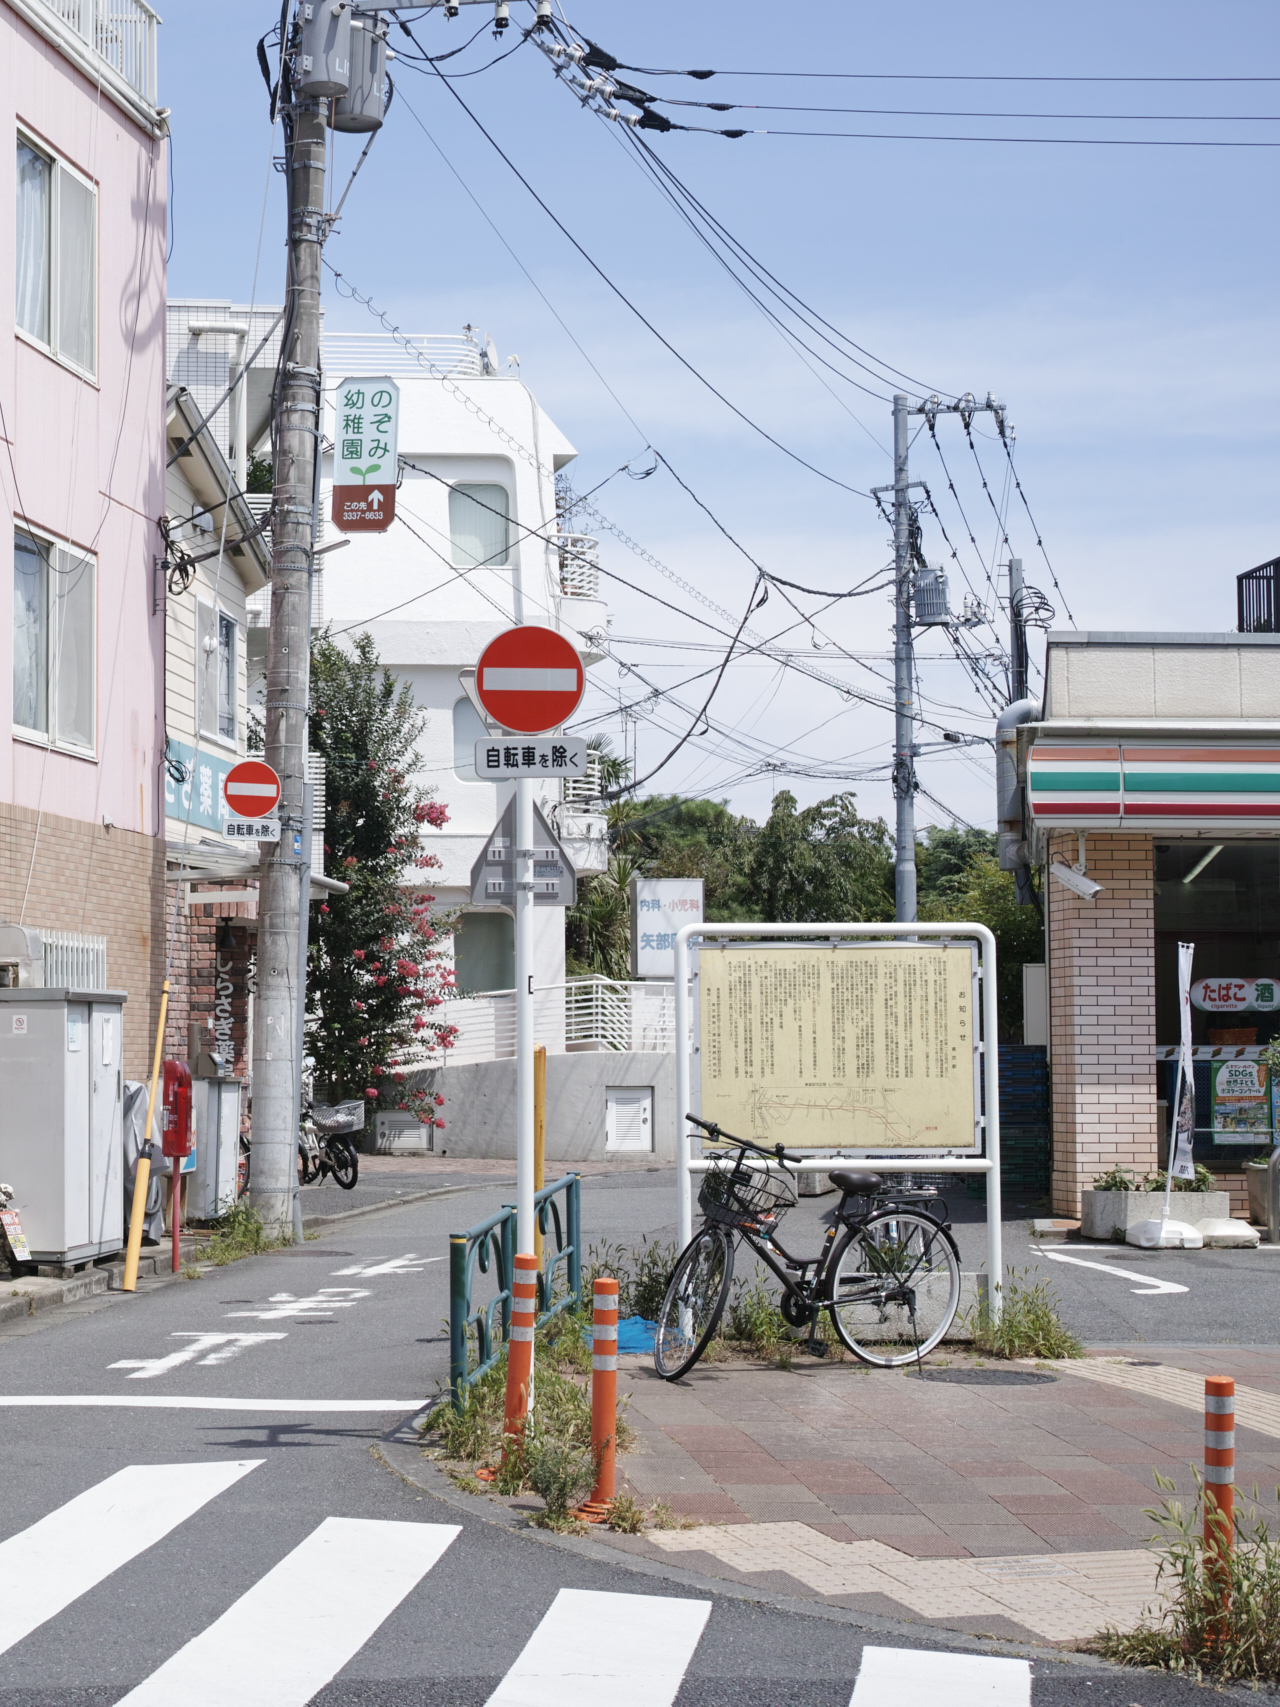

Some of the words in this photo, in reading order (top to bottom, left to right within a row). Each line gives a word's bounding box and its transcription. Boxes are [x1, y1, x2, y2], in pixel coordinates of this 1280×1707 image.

[341, 389, 365, 459] 幼稚園
[368, 390, 393, 459] のぞみ
[343, 502, 367, 510] この先
[343, 511, 384, 520] 3337-6633
[486, 745, 579, 769] 自転車を除く
[227, 823, 276, 837] 自転車を除く
[640, 898, 700, 913] 内科・小児科
[1202, 982, 1247, 1003] たばこ
[1254, 983, 1275, 1003] 酒
[958, 990, 967, 1042] お知らせ
[1228, 1069, 1254, 1078] SDGs
